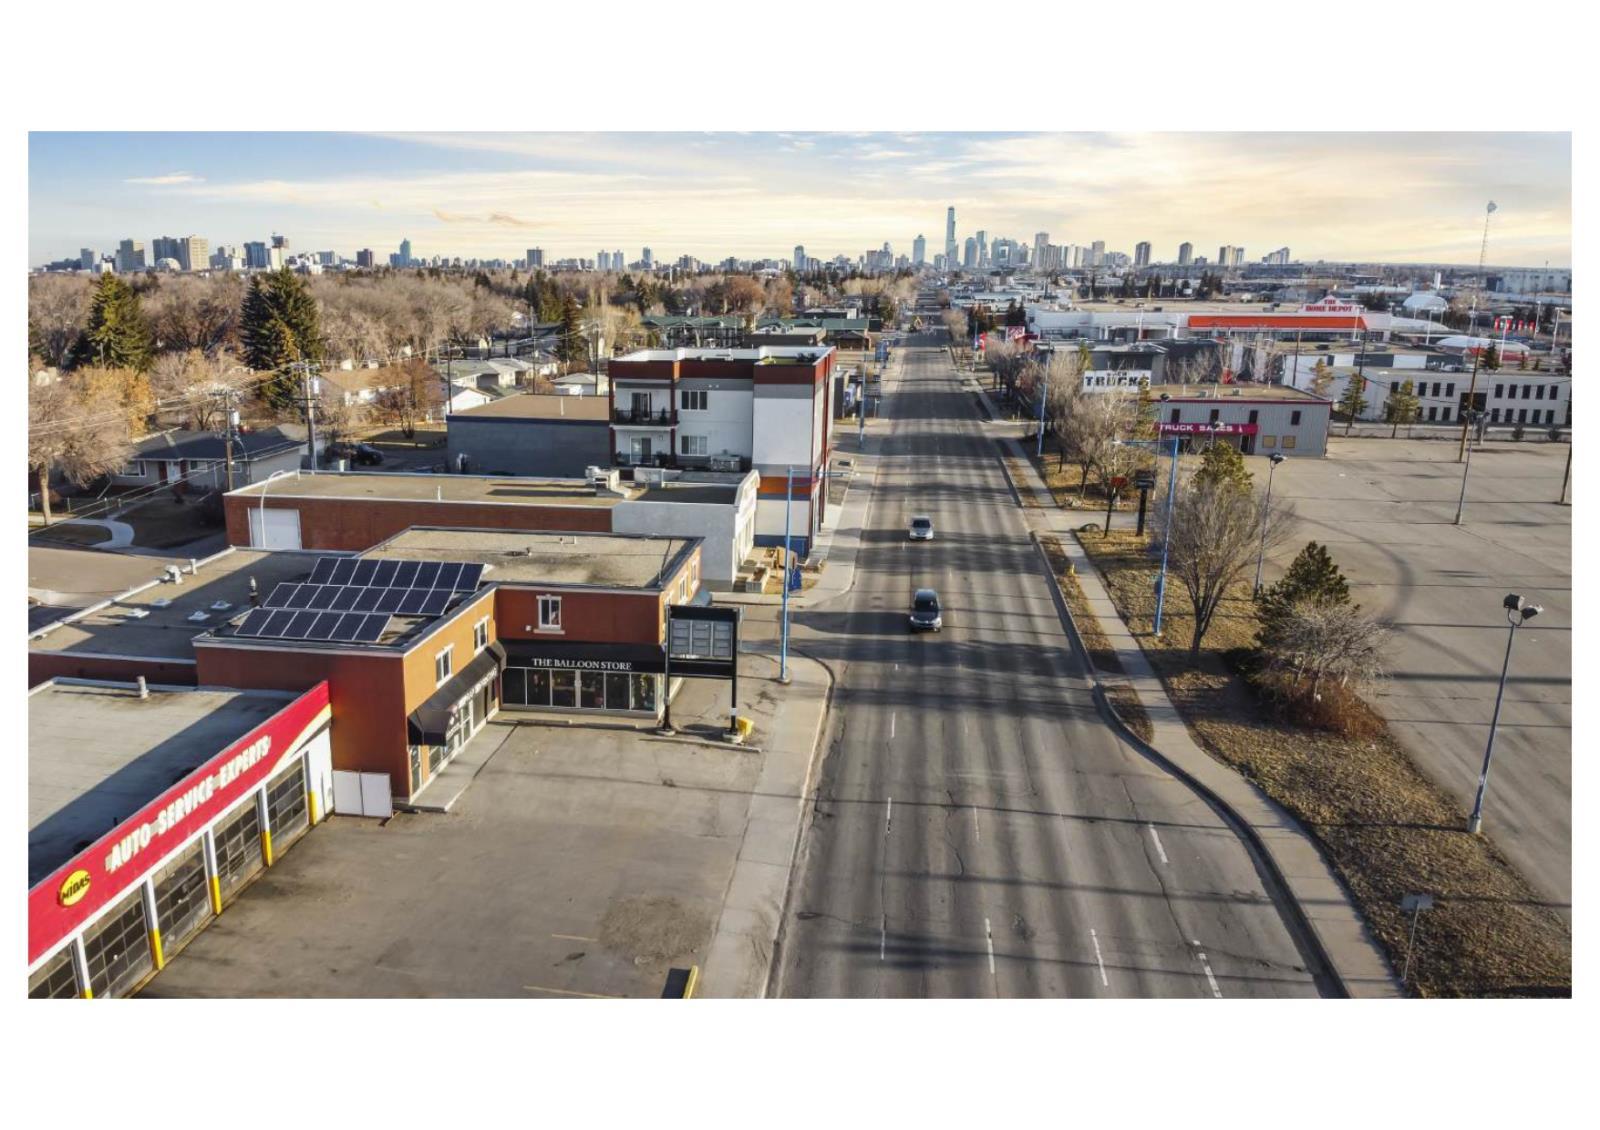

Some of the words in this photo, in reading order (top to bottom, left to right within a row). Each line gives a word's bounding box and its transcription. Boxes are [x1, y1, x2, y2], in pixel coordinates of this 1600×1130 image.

[531, 658, 553, 667] THE
[554, 659, 600, 670] BALLOON
[601, 661, 632, 671] STORE
[109, 823, 151, 873] AUTO
[157, 774, 214, 836] SERVICE
[219, 735, 272, 790] EXPERTS
[62, 873, 90, 899] MIDAS
